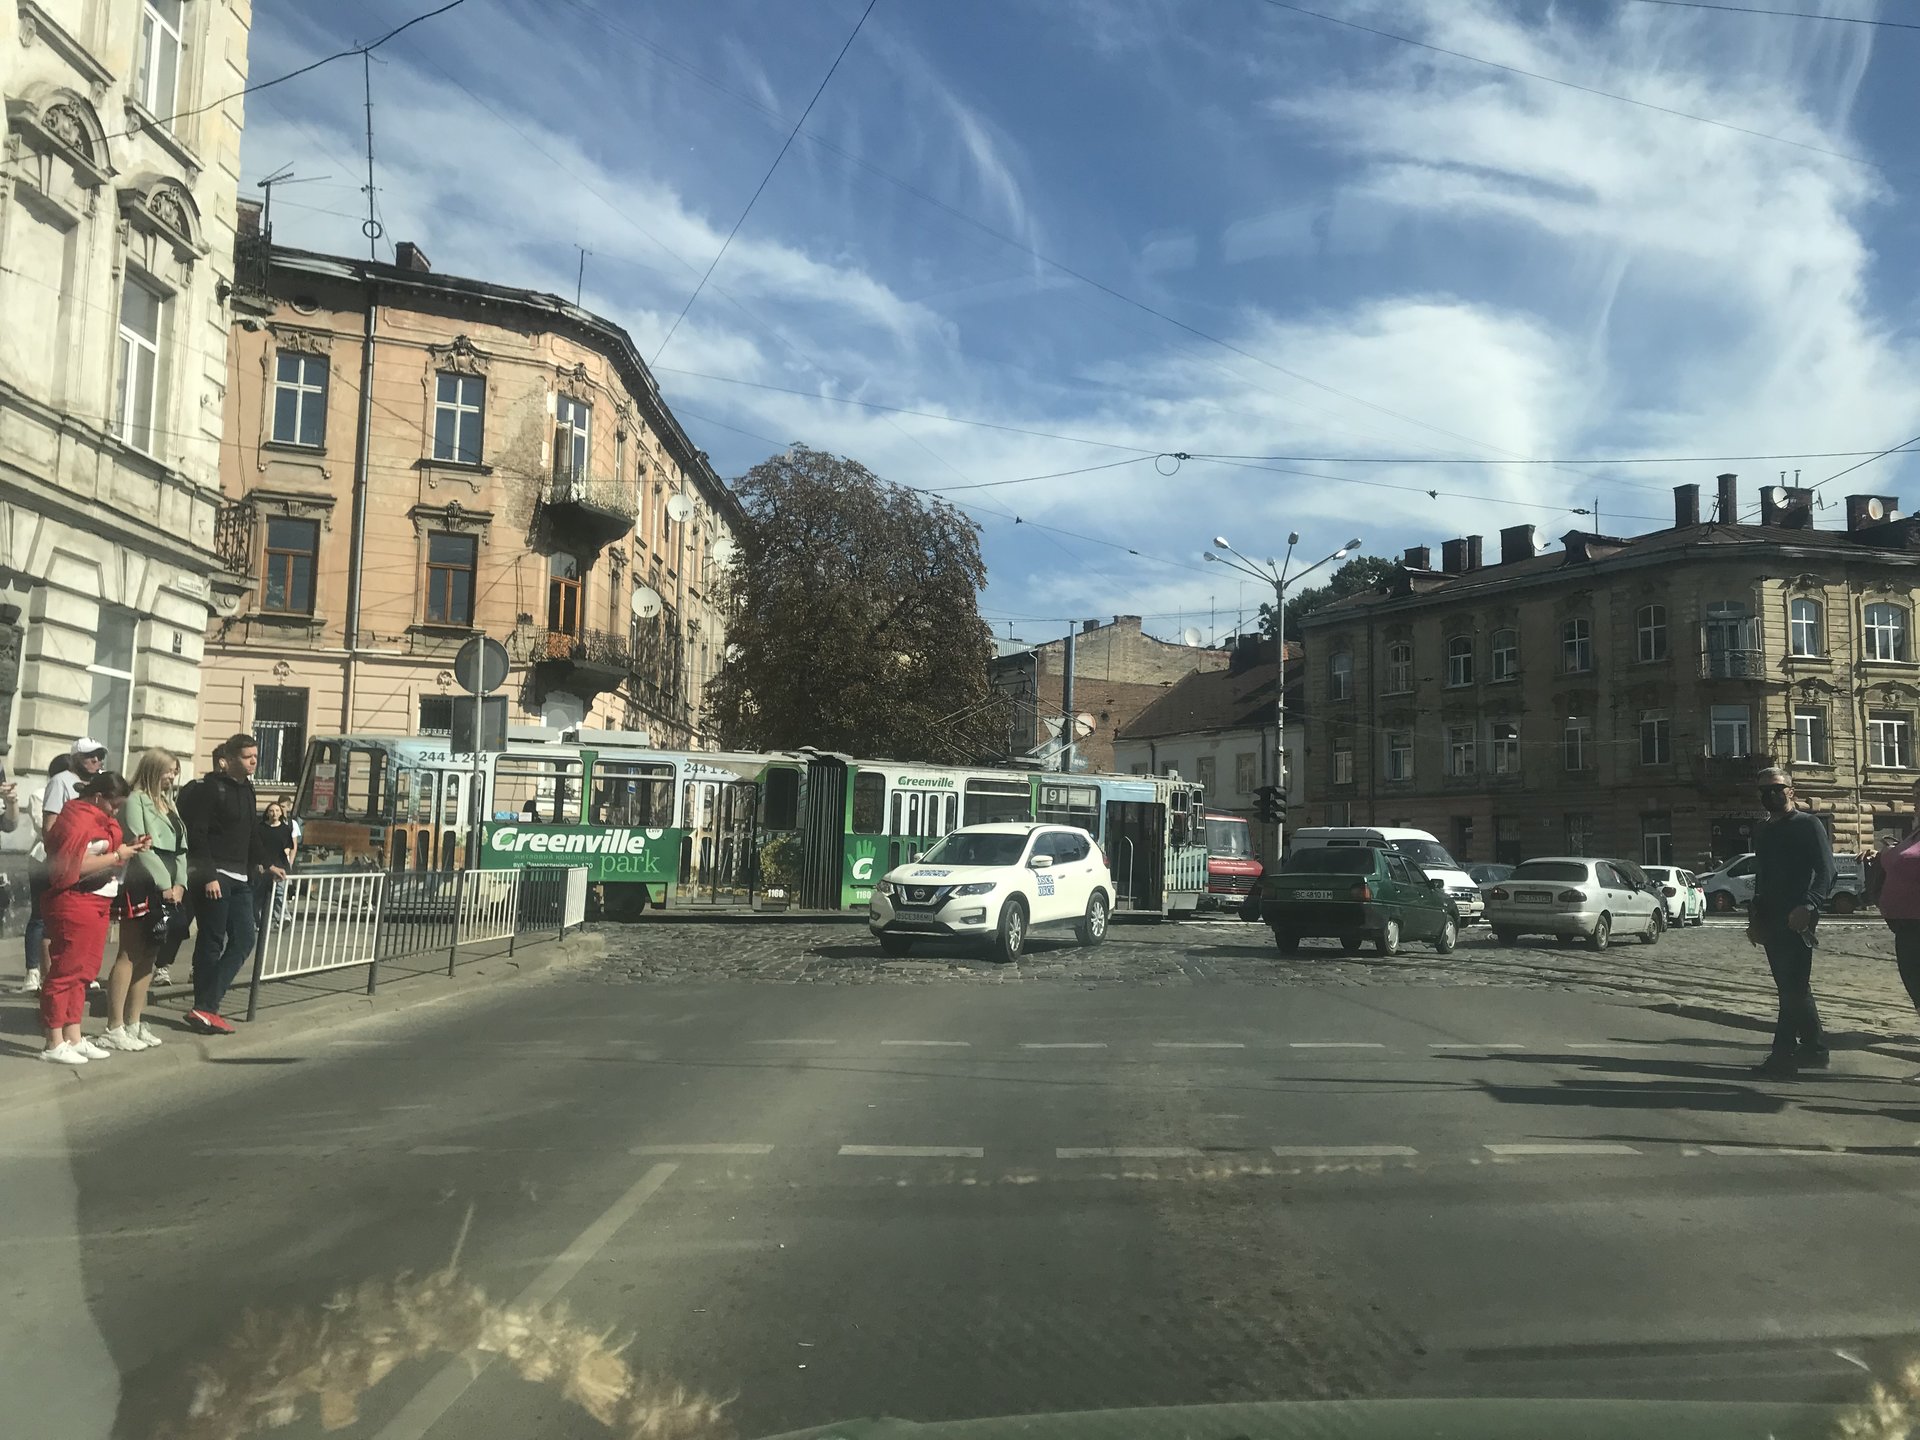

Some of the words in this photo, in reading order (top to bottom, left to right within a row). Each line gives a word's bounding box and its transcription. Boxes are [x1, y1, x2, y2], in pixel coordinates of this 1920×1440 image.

[418, 750, 446, 762] 244
[683, 763, 707, 774] 244
[898, 775, 954, 788] Greenville
[1049, 789, 1058, 801] 9
[491, 827, 645, 854] Greenville
[600, 849, 660, 879] park
